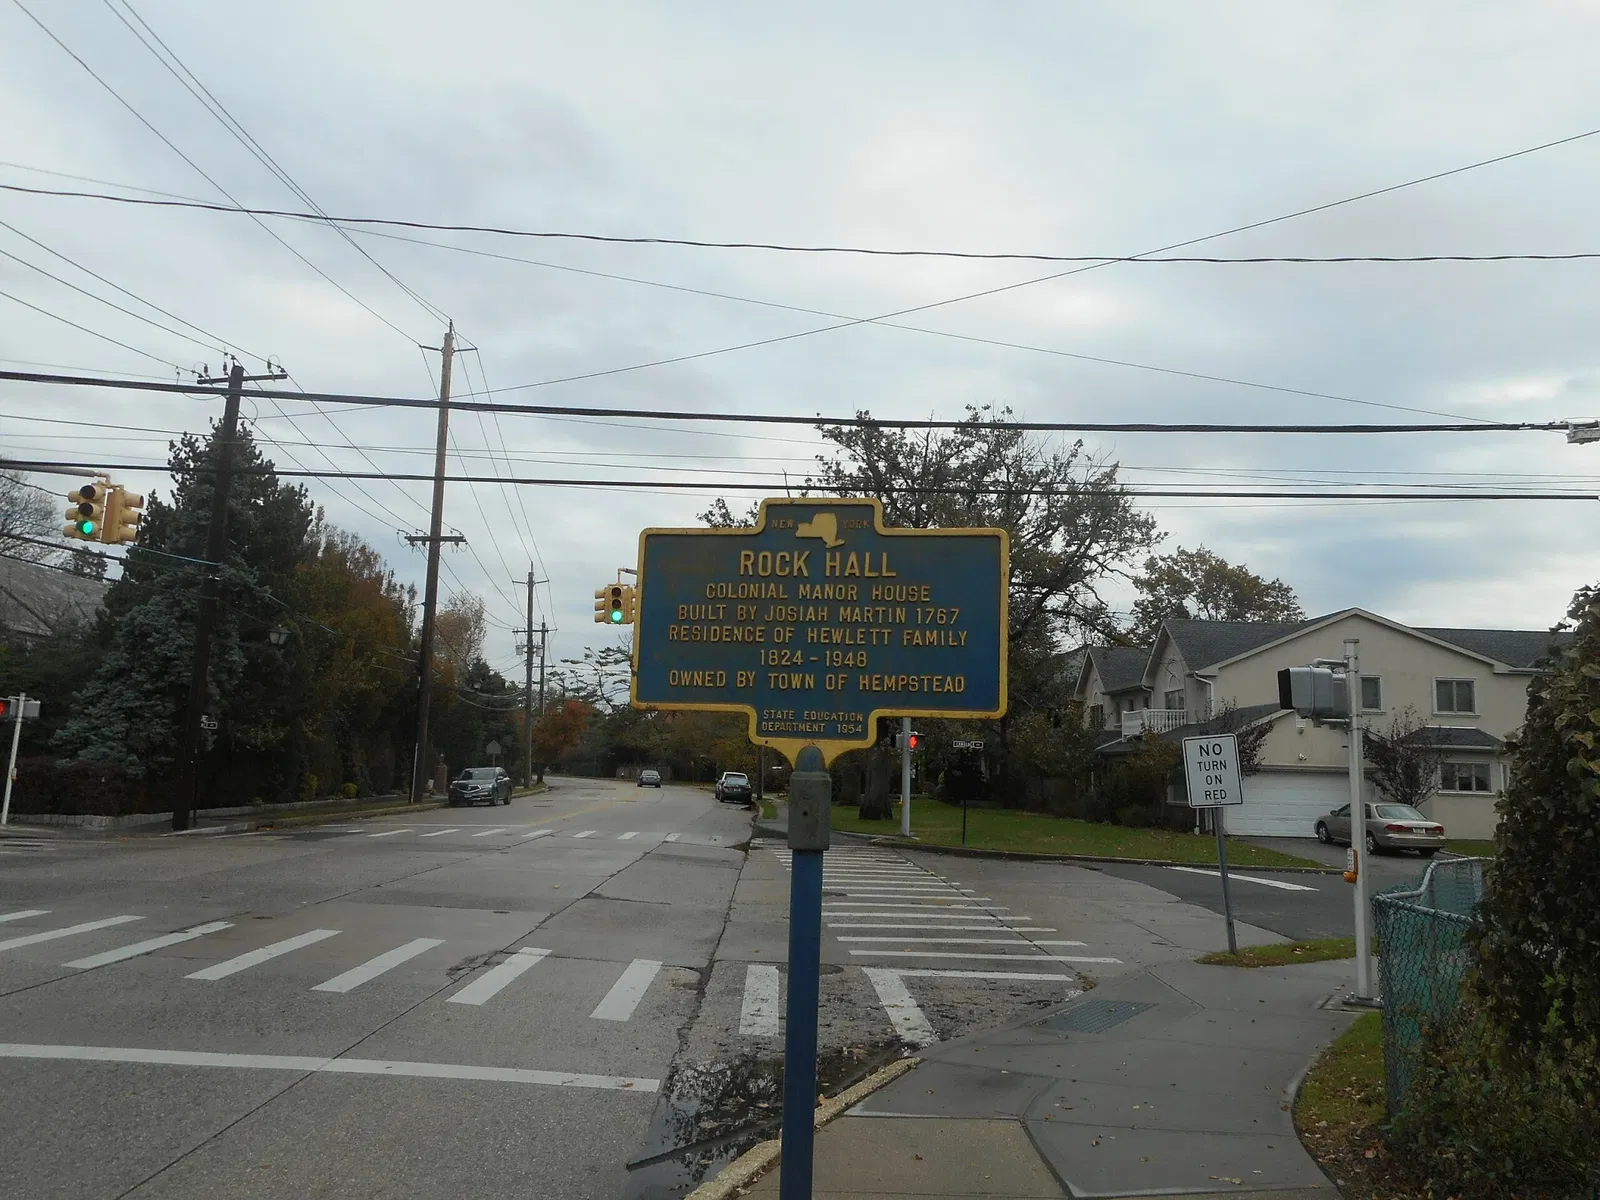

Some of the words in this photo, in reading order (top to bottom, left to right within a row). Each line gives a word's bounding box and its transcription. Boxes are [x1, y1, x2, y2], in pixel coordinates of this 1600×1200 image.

[772, 519, 794, 529] NEW
[843, 519, 870, 529] YORK
[739, 550, 812, 577] ROCK
[825, 551, 897, 578] HALL
[706, 582, 788, 599] COLONIAL
[798, 583, 858, 600] MANOR
[872, 584, 931, 602] HOUSE
[678, 604, 727, 621] BUILT
[737, 605, 757, 621] BY
[764, 606, 828, 622] JOSIAH
[839, 606, 906, 624] MARTIN
[916, 608, 960, 625] 1767
[669, 625, 765, 643] RESIDENCE
[773, 627, 795, 643] OF
[807, 627, 892, 645] HEWLETT
[903, 629, 968, 647] FAMILY
[669, 670, 727, 687] OWNED
[736, 671, 756, 687] BY
[768, 673, 815, 690] TOWN
[825, 673, 848, 690] OF
[859, 674, 966, 693] HEMPSTEAD
[763, 709, 796, 720] STATE
[804, 710, 863, 722] EDUCATION
[762, 721, 826, 732] DEPARTMENT
[836, 723, 863, 734] 1954
[1199, 743, 1223, 757] NO
[1196, 760, 1227, 772] TURN
[1205, 774, 1223, 785] ON
[1204, 789, 1227, 800] RED
